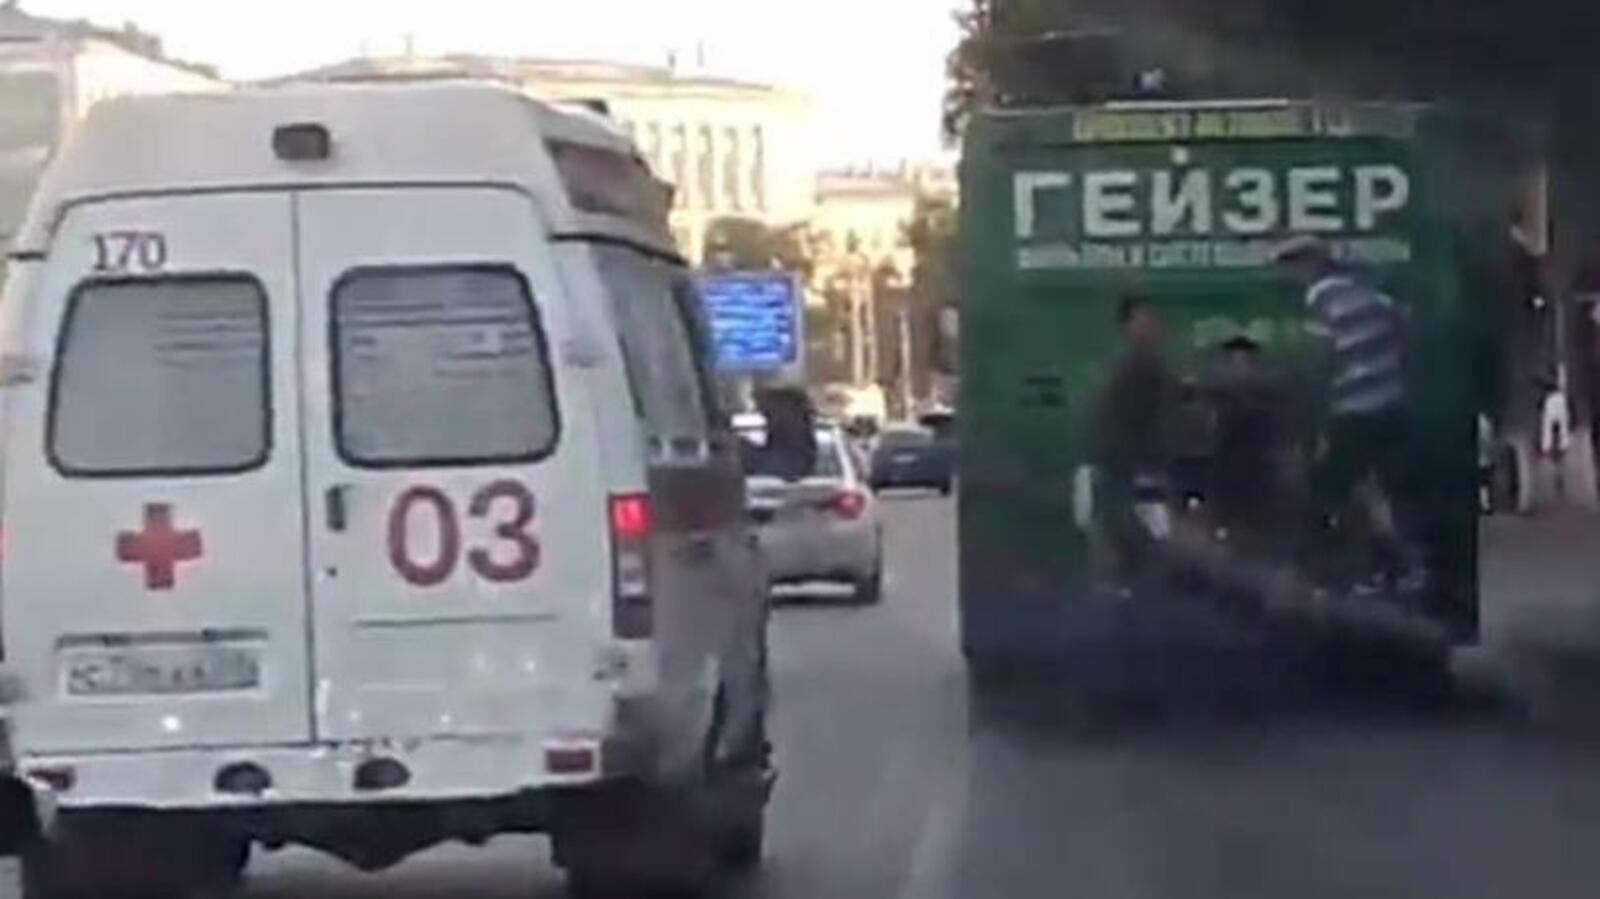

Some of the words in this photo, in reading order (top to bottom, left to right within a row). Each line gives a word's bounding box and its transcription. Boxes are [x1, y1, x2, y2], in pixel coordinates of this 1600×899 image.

[1012, 146, 1410, 238] ГЕЙЗЕР
[93, 229, 166, 270] 170
[387, 479, 541, 587] 03
